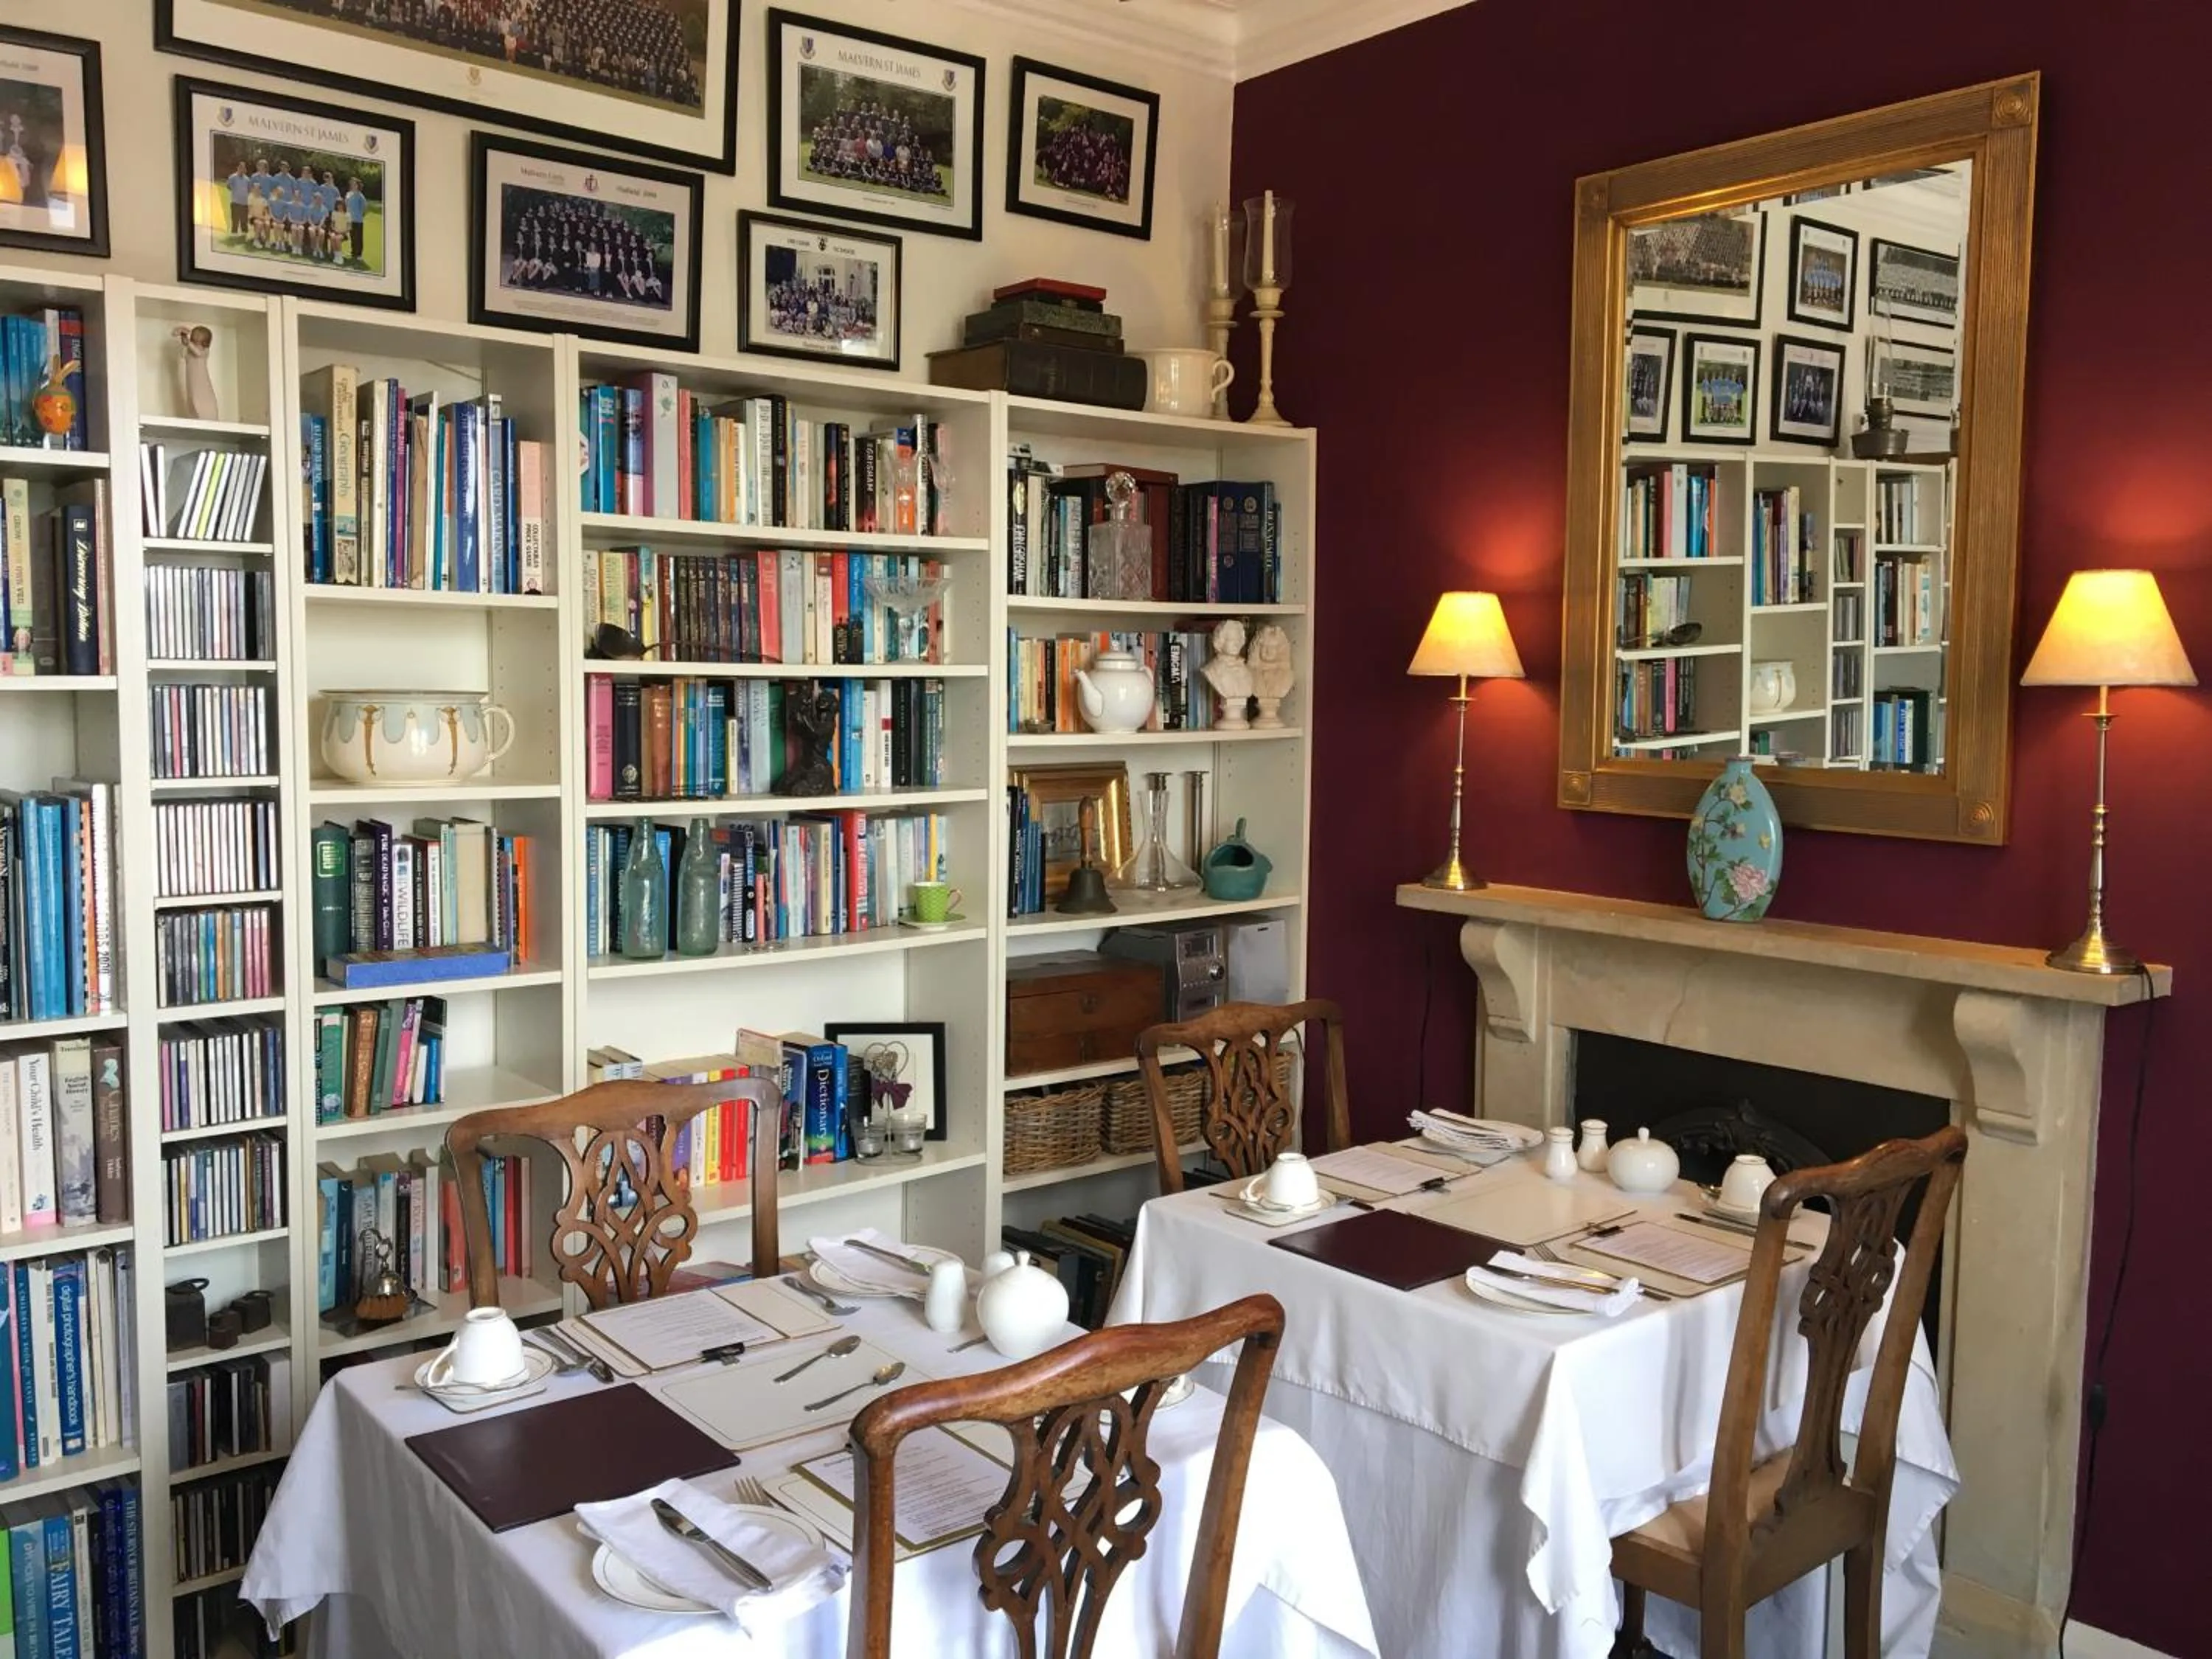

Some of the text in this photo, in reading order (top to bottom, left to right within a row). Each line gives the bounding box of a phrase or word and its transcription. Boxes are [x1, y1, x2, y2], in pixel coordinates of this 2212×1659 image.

[838, 50, 921, 79] MALVERN ST JAMES
[248, 115, 350, 144] MALVERN ST JAMES
[338, 433, 352, 498] Geography
[14, 515, 22, 539] GROW
[1015, 546, 1026, 582] GRISHAM
[72, 538, 92, 642] Discovering Britain
[1171, 645, 1180, 683] ENIGMA
[397, 887, 409, 946] WILDLIFE
[29, 1059, 44, 1151] Your Child's Health
[815, 1068, 830, 1140] Dictionary
[60, 1285, 79, 1427] digital photographer's handbook
[126, 1498, 136, 1520] THE
[49, 1560, 70, 1609] FAIRY
